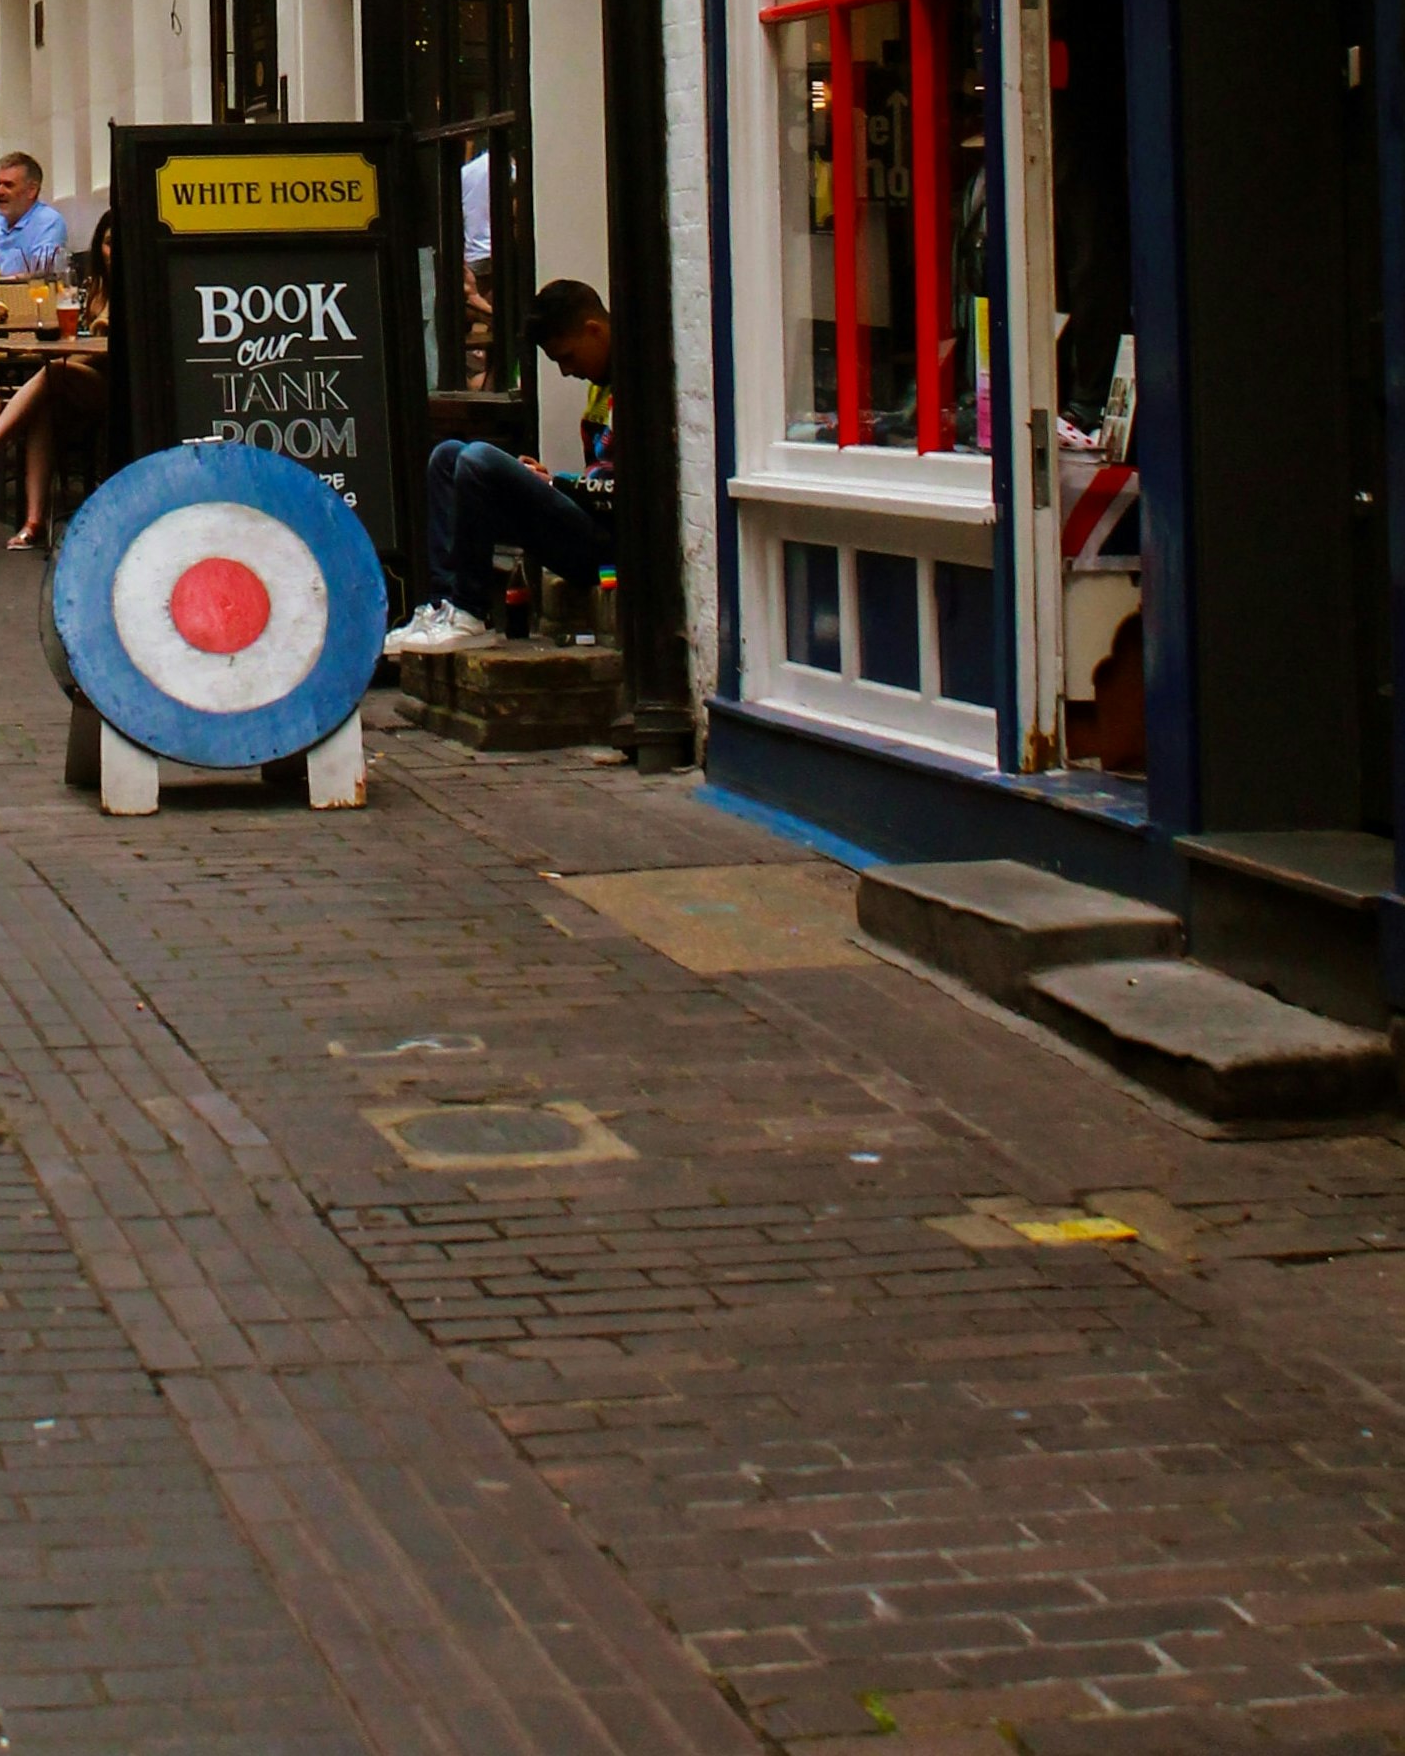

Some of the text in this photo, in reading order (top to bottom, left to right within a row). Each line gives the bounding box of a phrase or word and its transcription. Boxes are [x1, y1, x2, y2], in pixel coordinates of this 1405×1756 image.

[172, 180, 363, 205] WHITE HORSE
[195, 283, 357, 344] BOOK
[237, 332, 303, 367] our
[212, 370, 349, 413] TANK
